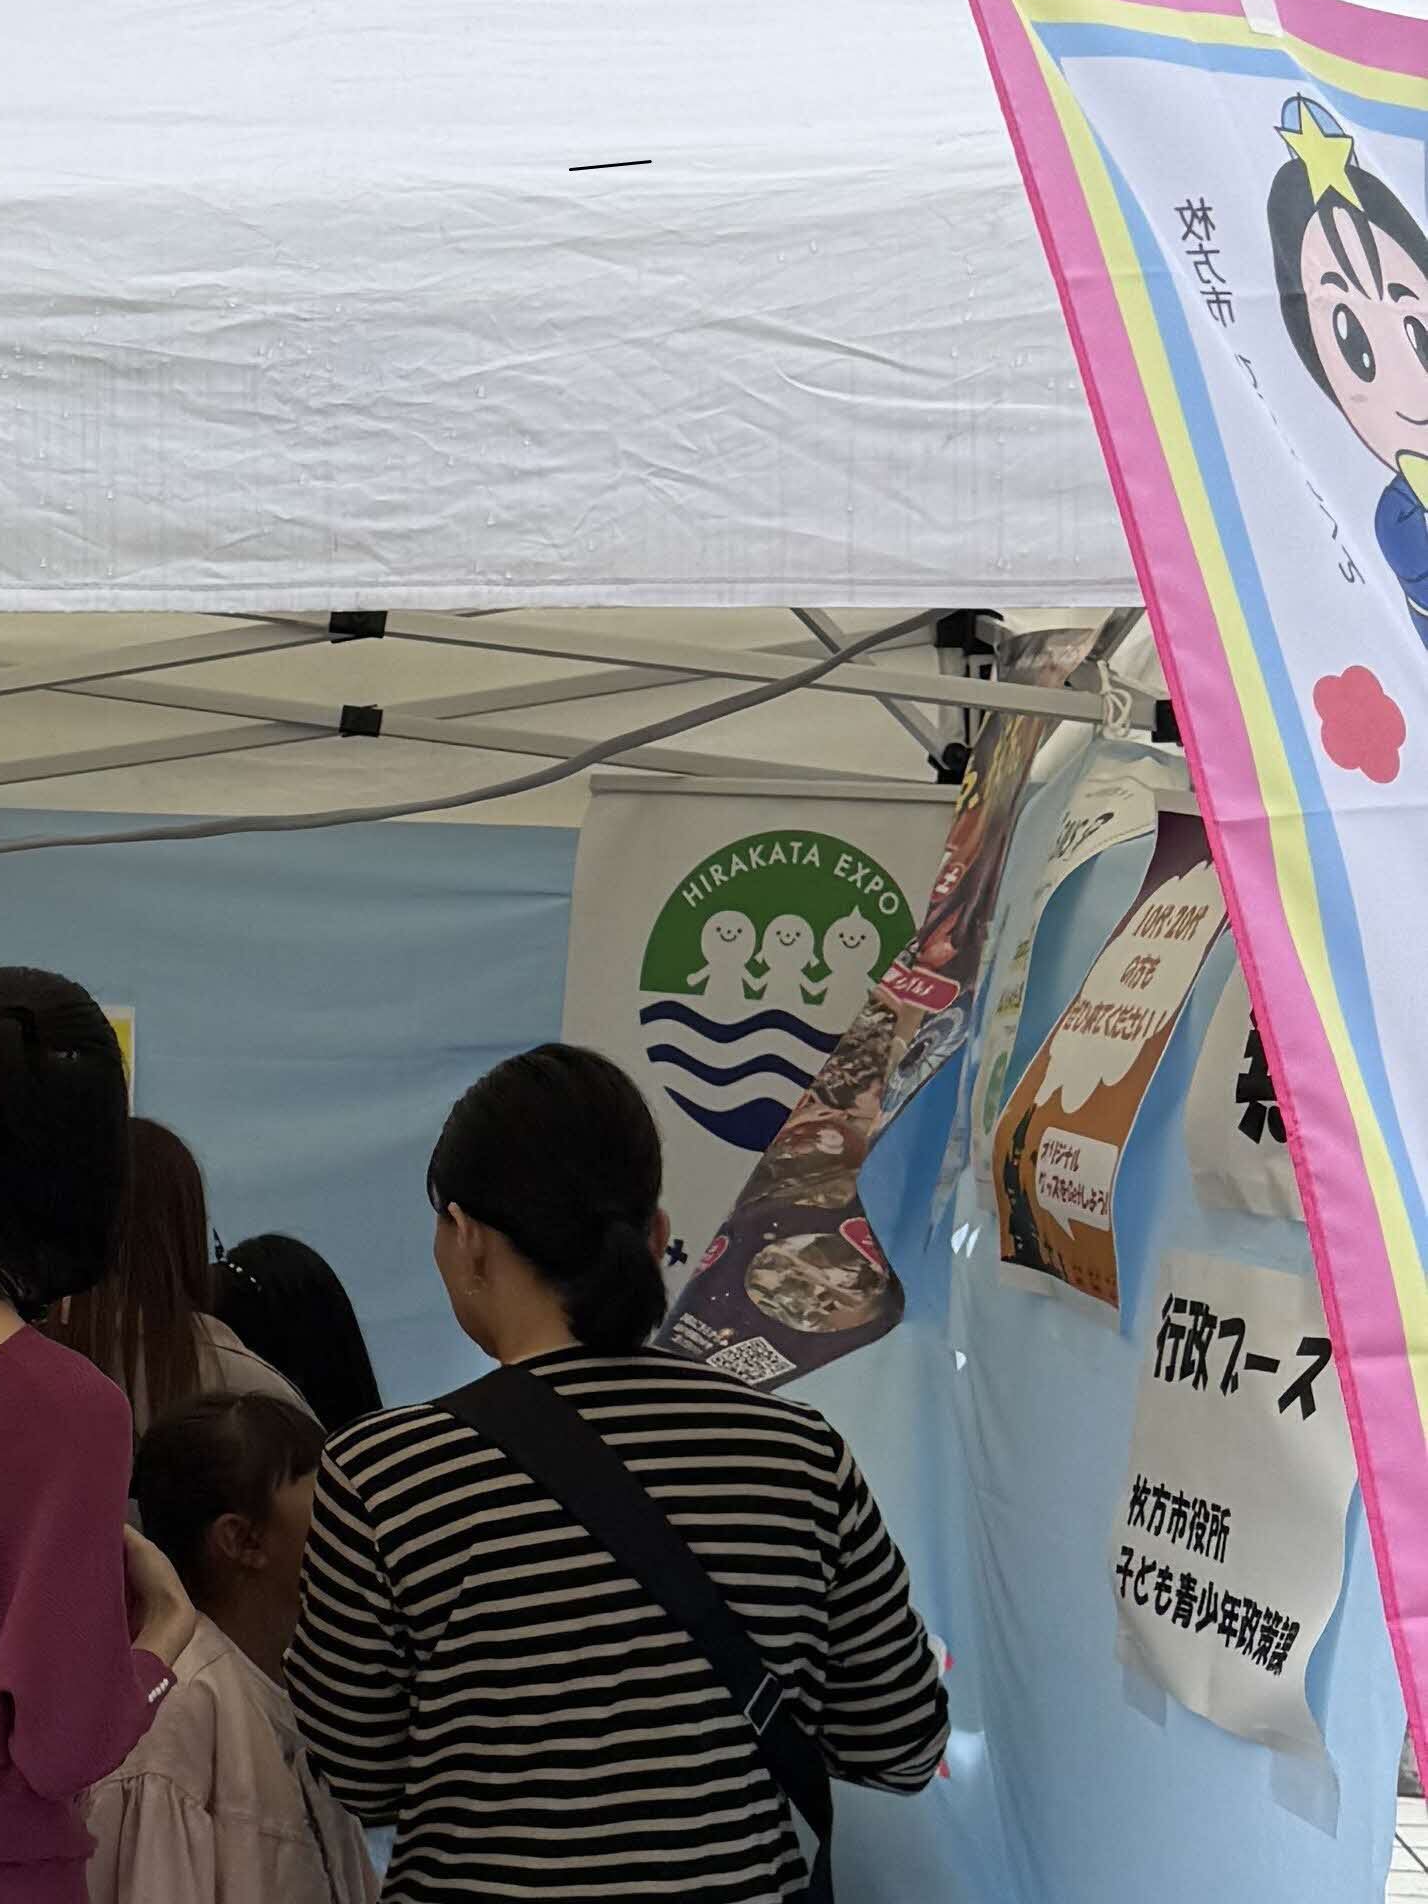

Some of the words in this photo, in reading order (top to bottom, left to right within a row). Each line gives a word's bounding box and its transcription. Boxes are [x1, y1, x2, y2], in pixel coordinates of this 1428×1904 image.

[682, 841, 821, 908] HIRAKATA
[834, 853, 900, 915] EXPO
[1153, 1293, 1332, 1421] 行政ブース
[1127, 1474, 1232, 1564] 枚方市役所
[1115, 1546, 1300, 1676] 子ども青少年政策課
